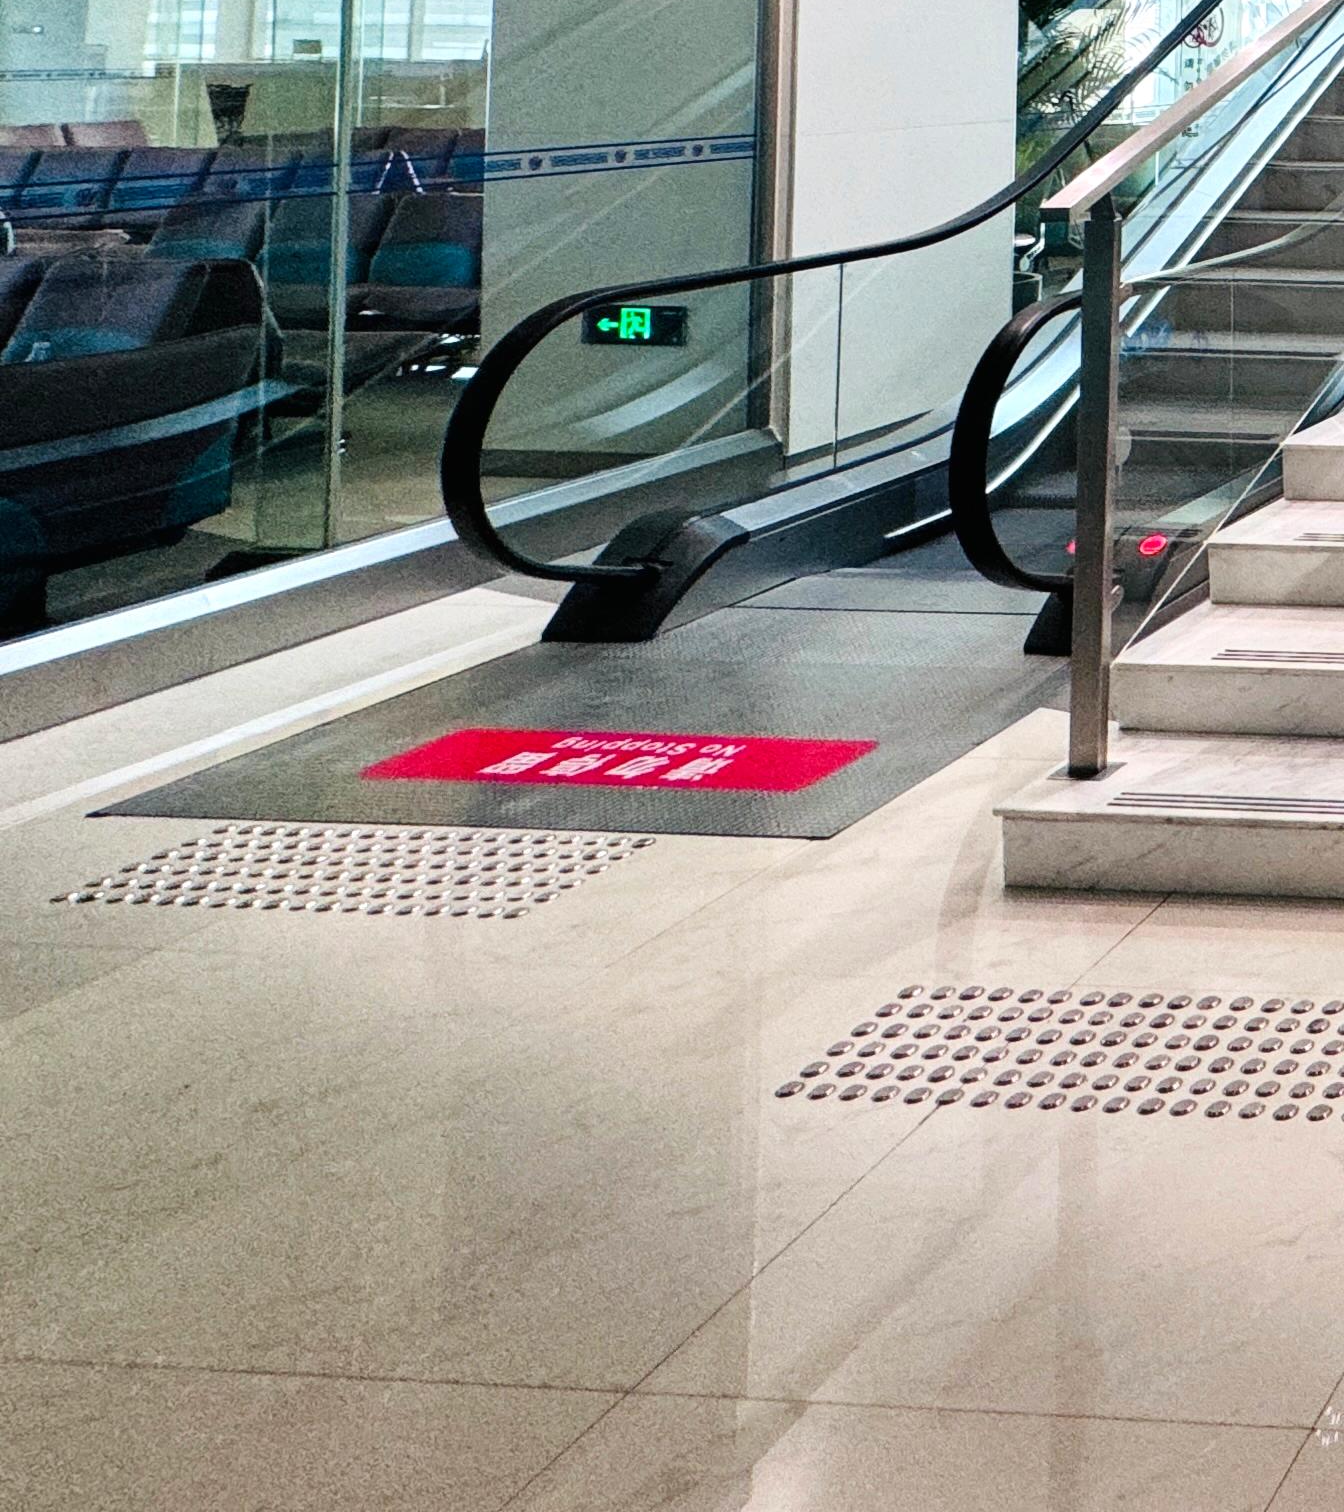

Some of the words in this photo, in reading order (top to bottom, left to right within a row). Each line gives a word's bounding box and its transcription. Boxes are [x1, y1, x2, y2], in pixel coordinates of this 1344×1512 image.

[552, 737, 697, 756] Stopping
[699, 744, 747, 757] No
[476, 751, 735, 782] 请勿停留
